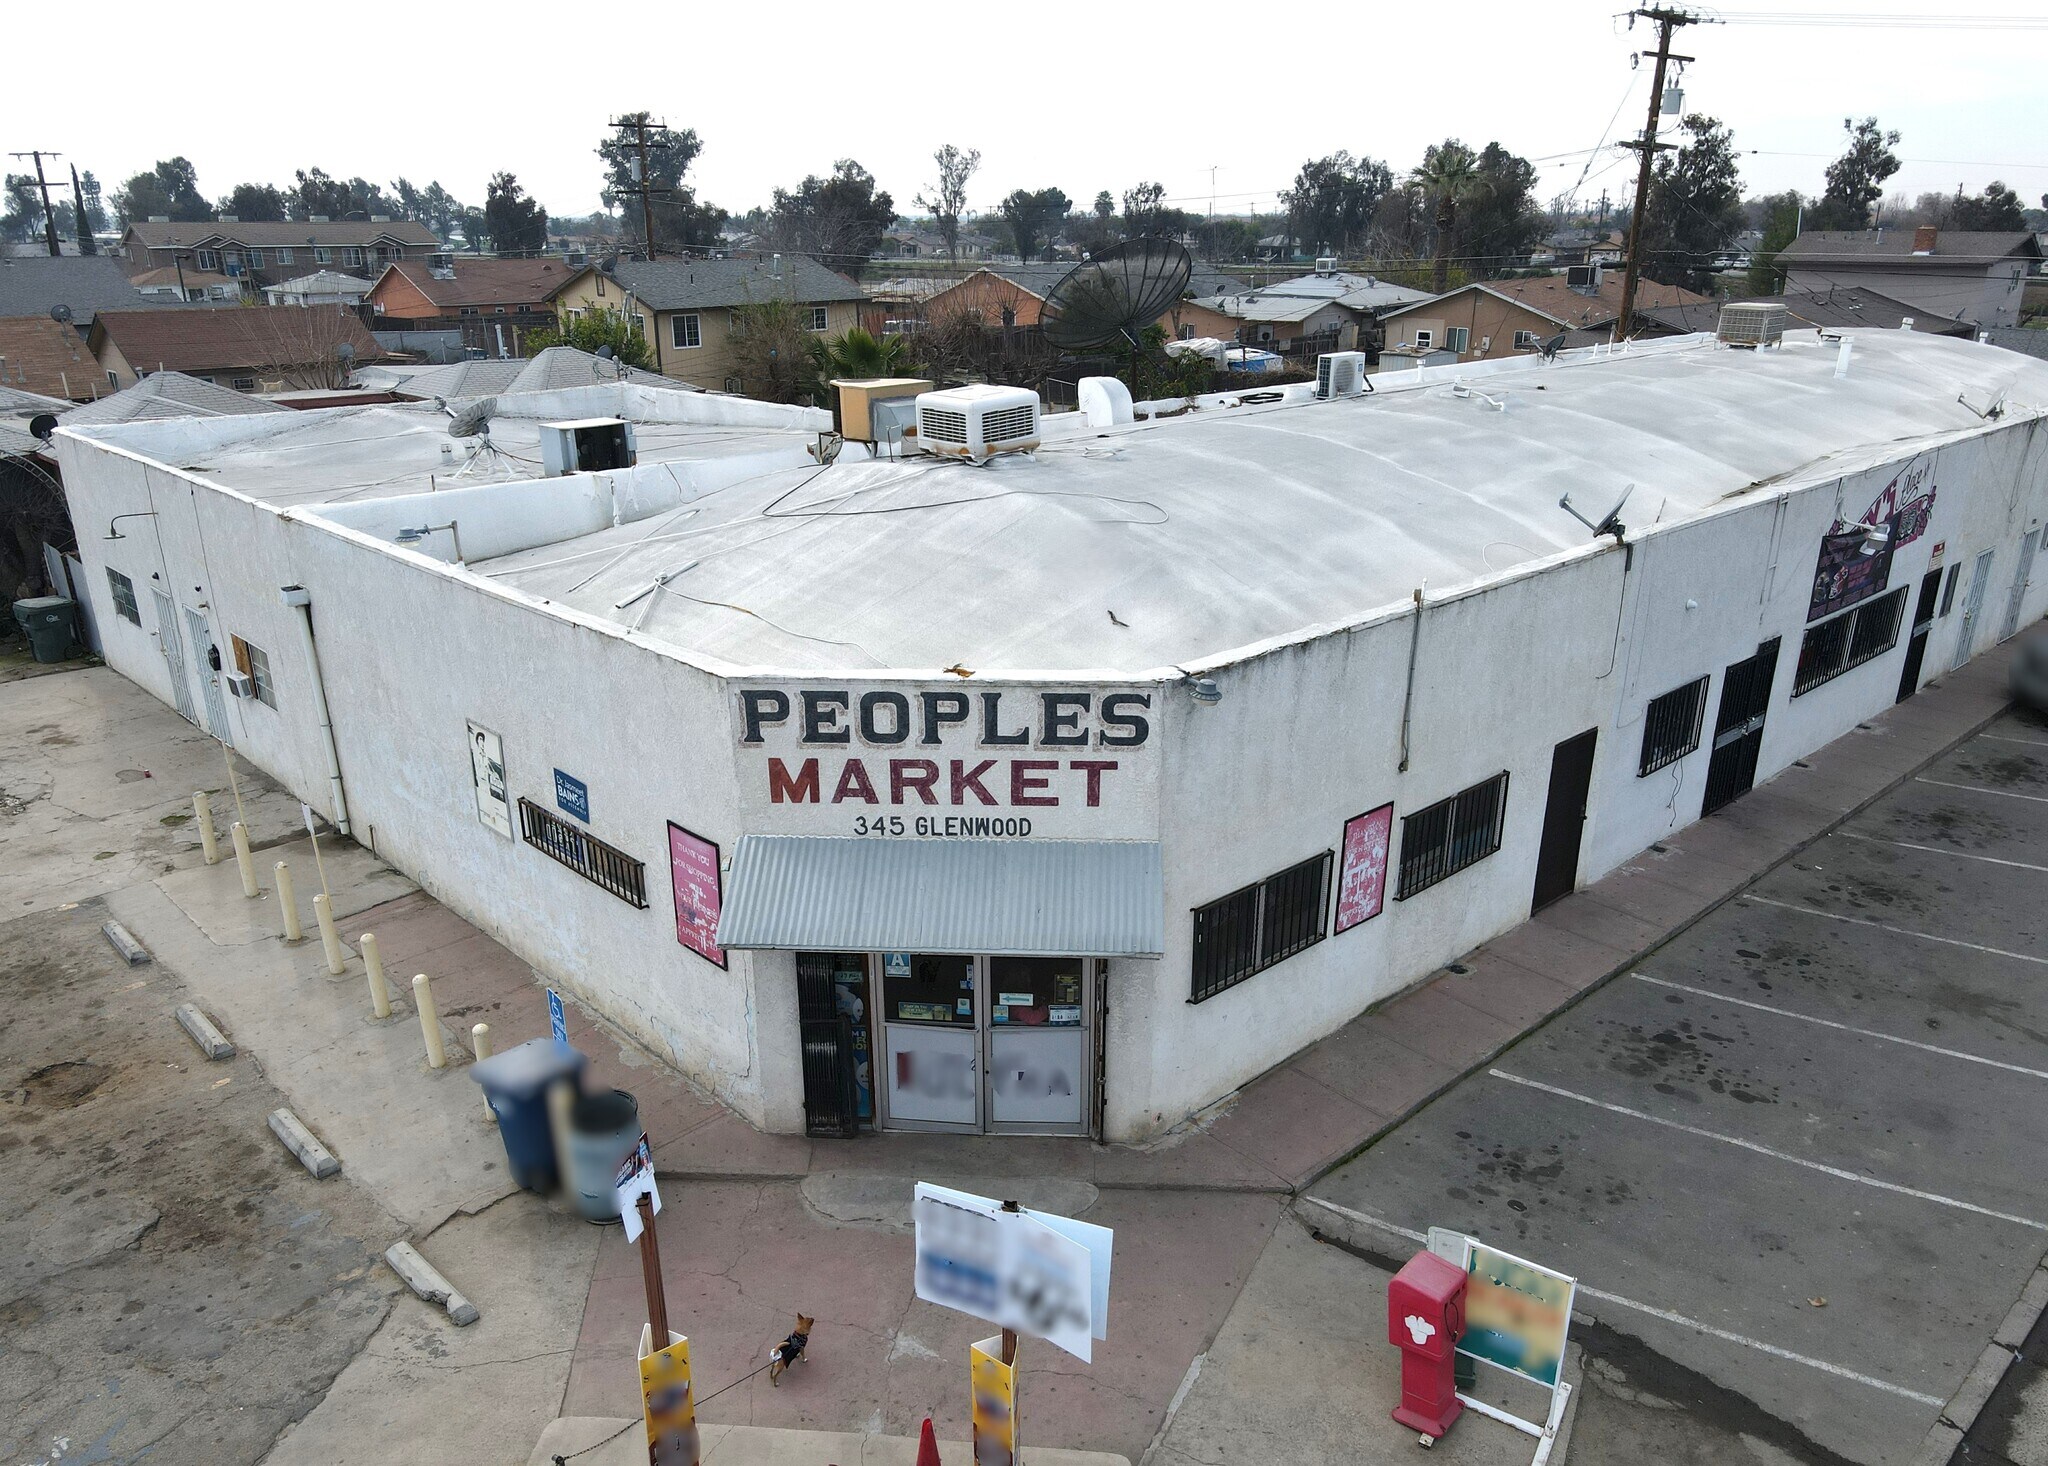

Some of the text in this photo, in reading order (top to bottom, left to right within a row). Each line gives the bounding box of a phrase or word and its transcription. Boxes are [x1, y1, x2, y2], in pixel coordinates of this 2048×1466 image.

[738, 689, 1152, 749] PEOPLES
[767, 757, 1119, 807] MARKET
[557, 784, 580, 806] BAINS
[853, 816, 1033, 837] 345 GLENWOOD
[676, 842, 710, 867] THANK YOU
[891, 952, 905, 966] A
